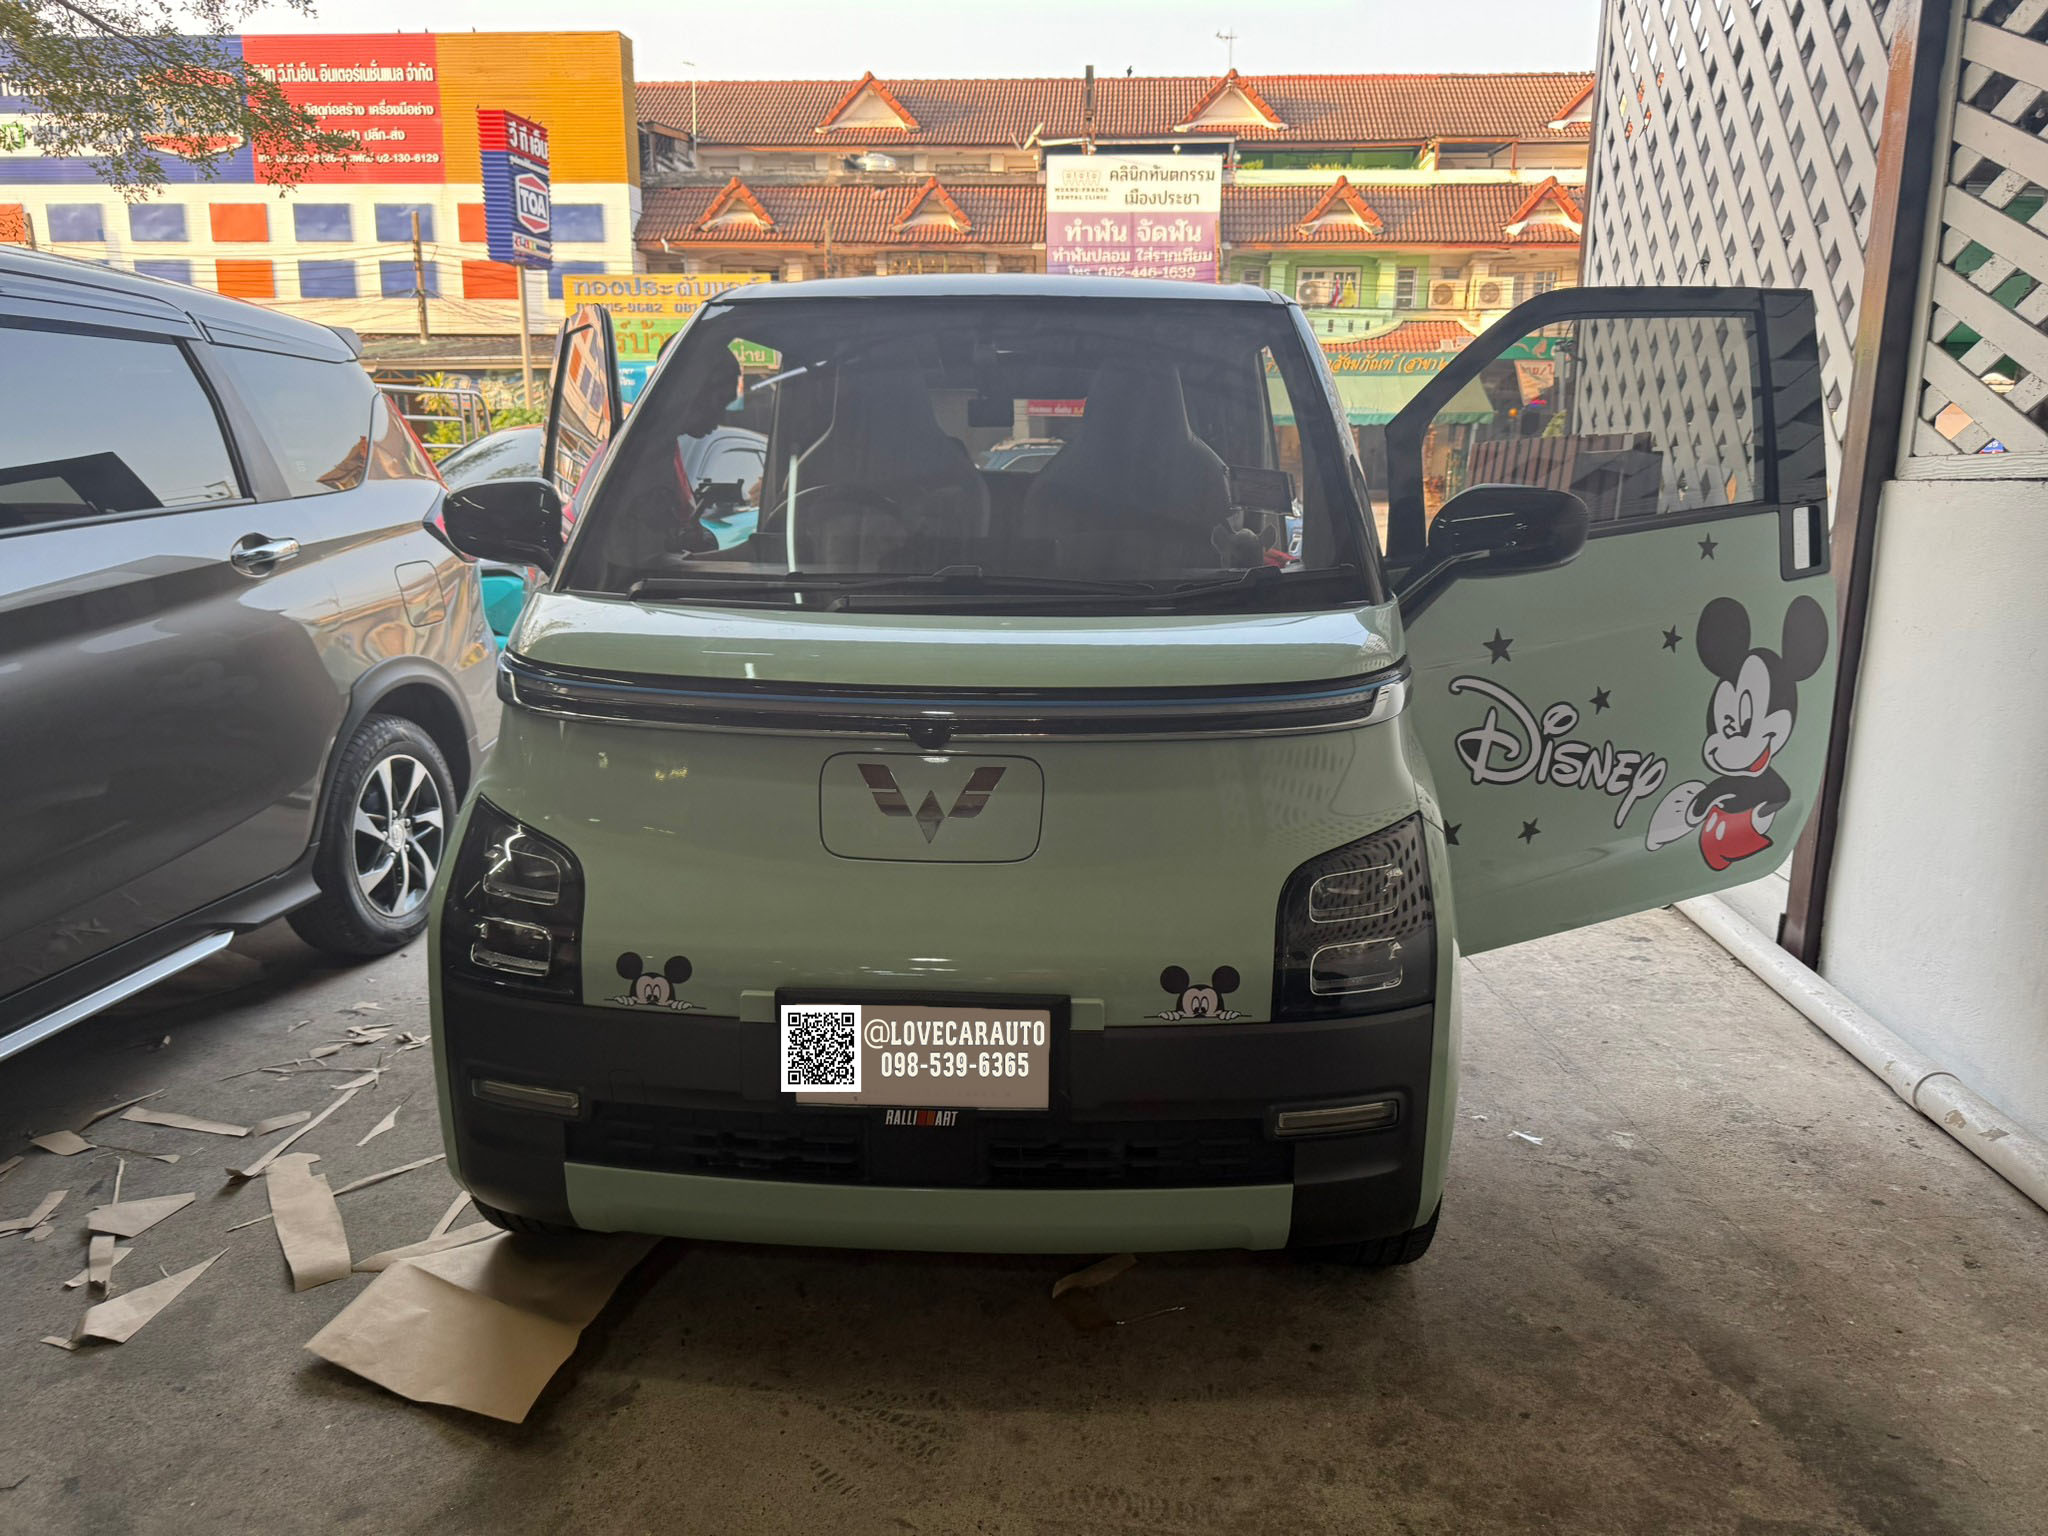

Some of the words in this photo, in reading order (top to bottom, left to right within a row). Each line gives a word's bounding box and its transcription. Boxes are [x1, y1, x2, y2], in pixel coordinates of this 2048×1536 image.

[406, 61, 434, 82] จำกัด
[369, 99, 435, 115] เครื่องมือช่าง
[1109, 165, 1216, 182] คลินิกทันตกรรม
[520, 188, 547, 219] TOA
[1124, 188, 1200, 206] เมืองประชา
[1064, 217, 1128, 243] ทำฟัน
[1136, 218, 1203, 243] จัดฟัน
[1052, 246, 1131, 263] ทำฟันปลอม
[1135, 246, 1213, 264] ใส่รากเทียม
[1098, 265, 1196, 279] 062-446-1639
